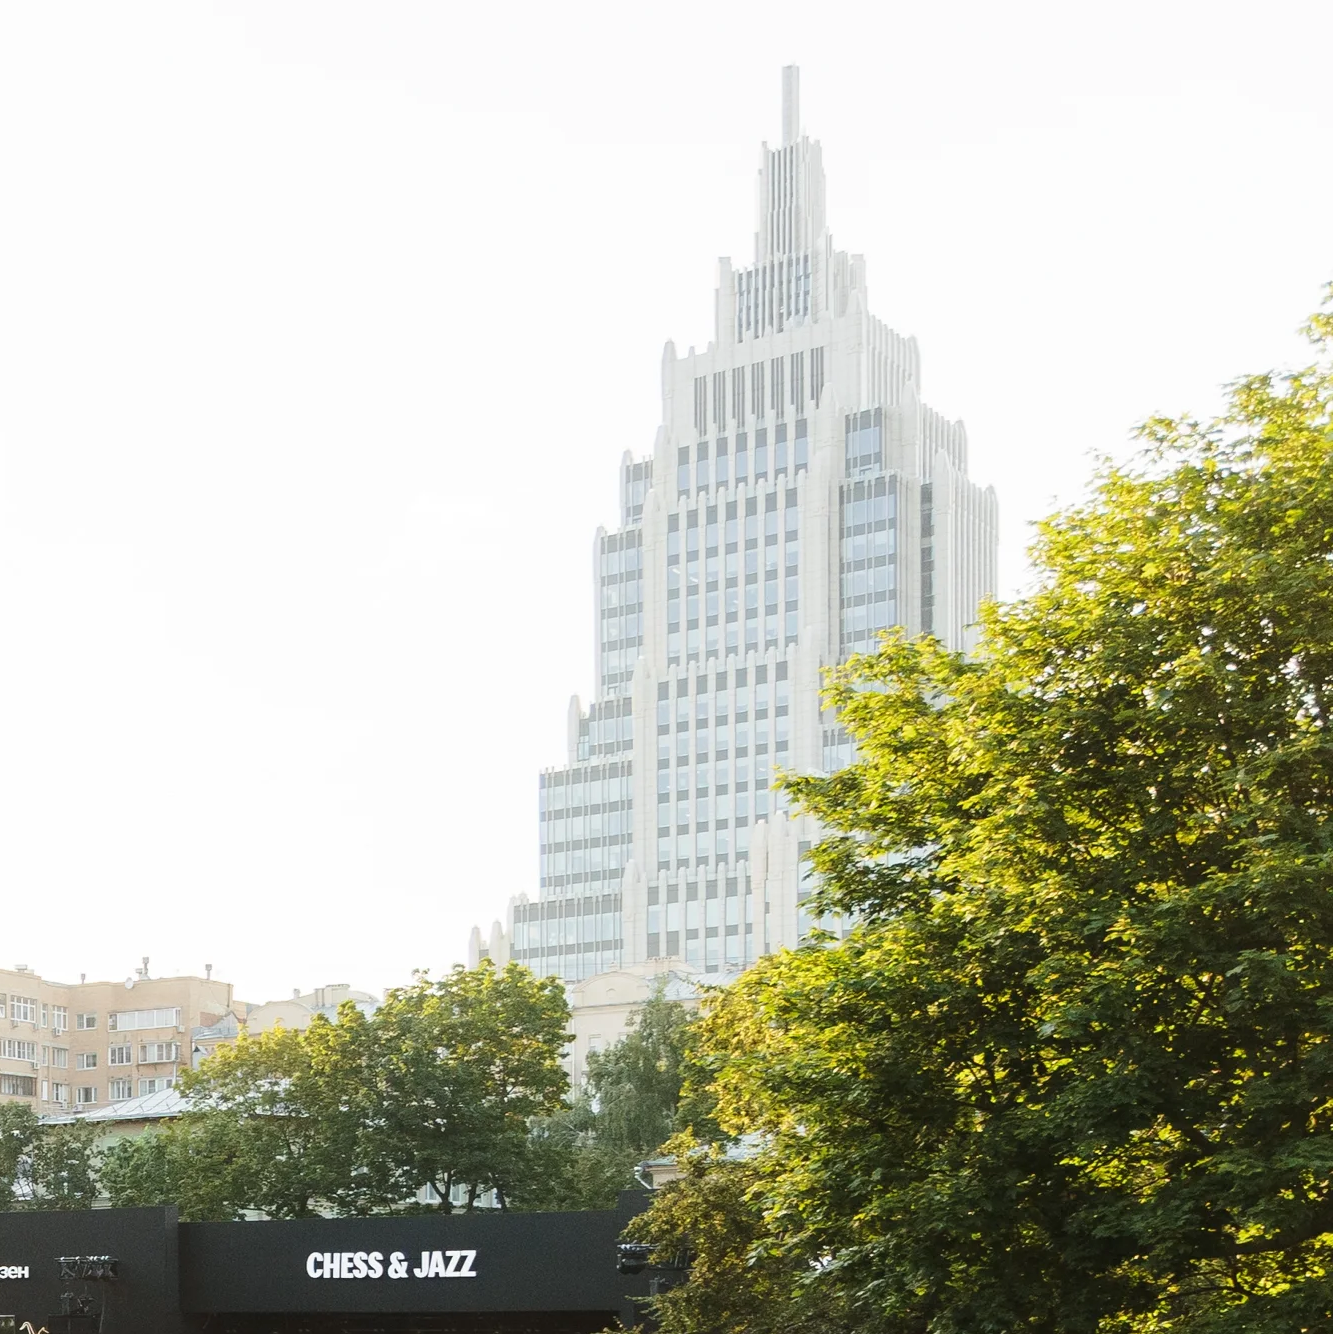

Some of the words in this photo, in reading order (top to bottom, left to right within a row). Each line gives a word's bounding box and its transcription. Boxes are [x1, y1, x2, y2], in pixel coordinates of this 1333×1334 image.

[306, 1251, 384, 1279] CHESS
[388, 1251, 408, 1279] &
[413, 1250, 477, 1278] JAZZ
